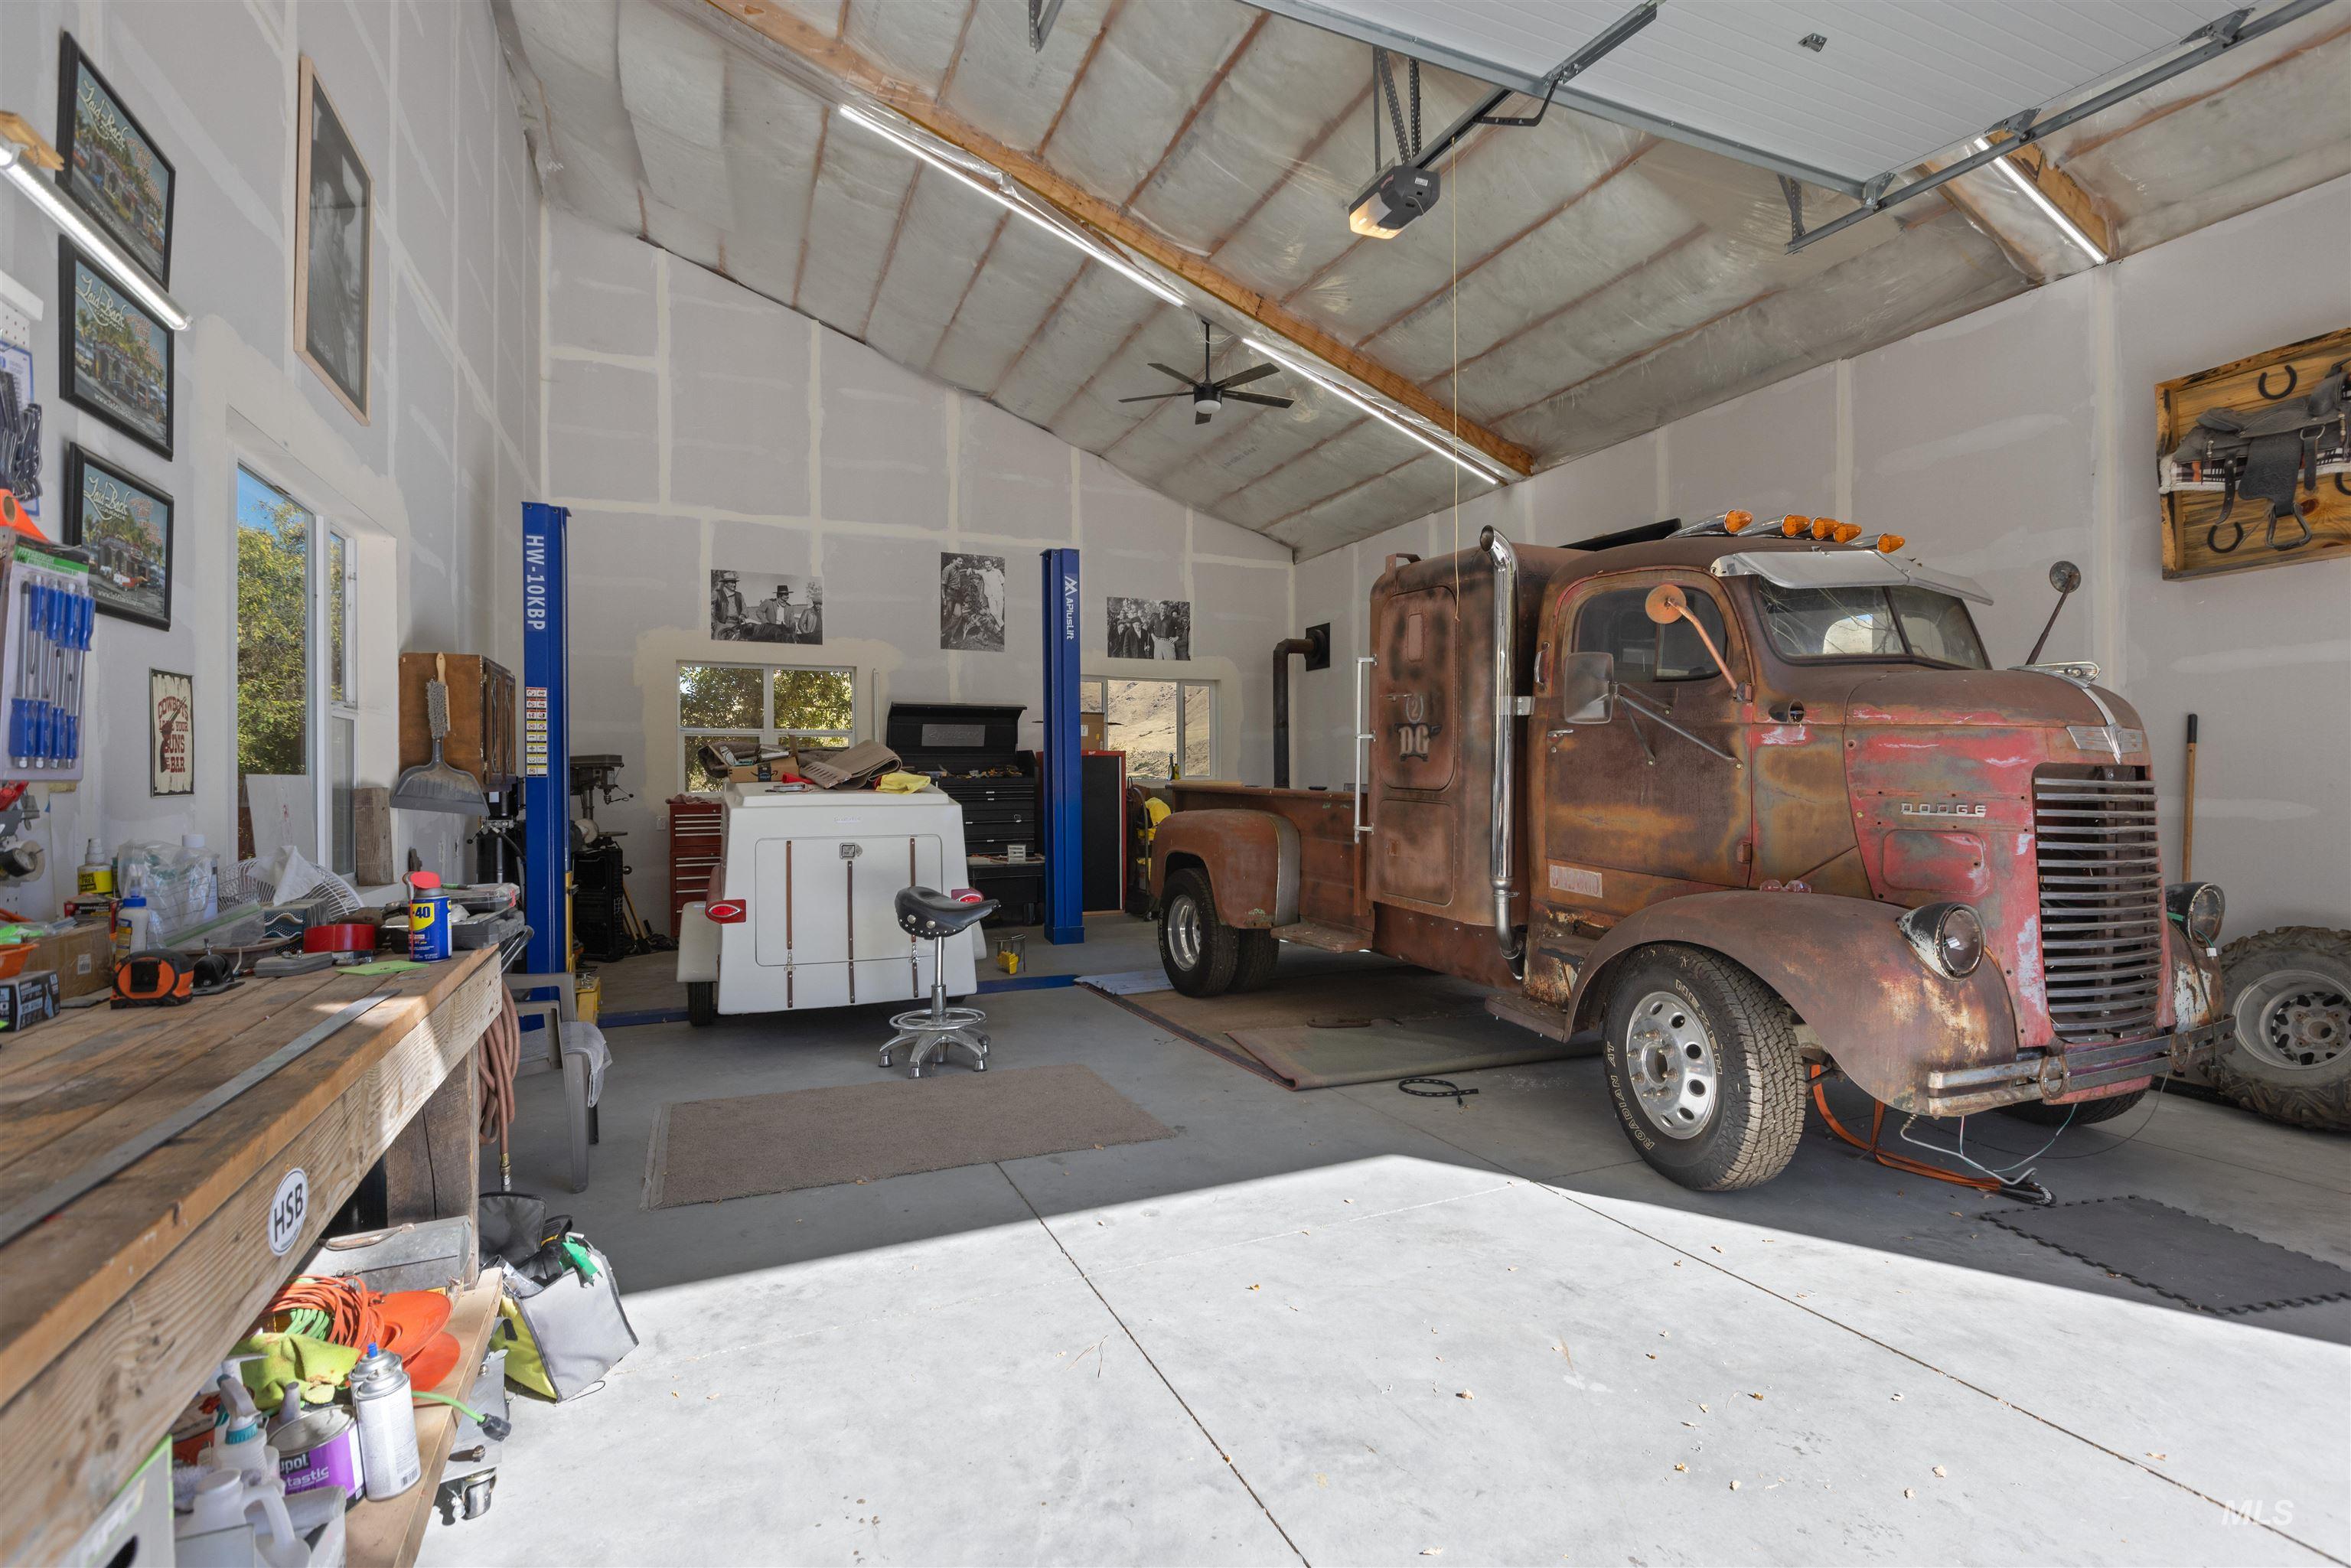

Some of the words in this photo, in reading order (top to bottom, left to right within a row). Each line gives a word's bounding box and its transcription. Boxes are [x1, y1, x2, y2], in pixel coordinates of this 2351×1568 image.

[76, 274, 127, 329] Laid-Back
[83, 476, 130, 520] Laid-Back
[526, 535, 546, 630] HW-10KBP
[175, 721, 188, 732] YOUR
[171, 756, 185, 773] BAR
[1900, 803, 1987, 817] DODGE
[413, 906, 431, 918] -40
[1675, 979, 1723, 1074] NEXEN
[1607, 1041, 1616, 1067] AT
[1610, 1074, 1655, 1151] ROADIAN
[274, 1182, 303, 1244] HSB
[286, 1466, 329, 1487] tastic
